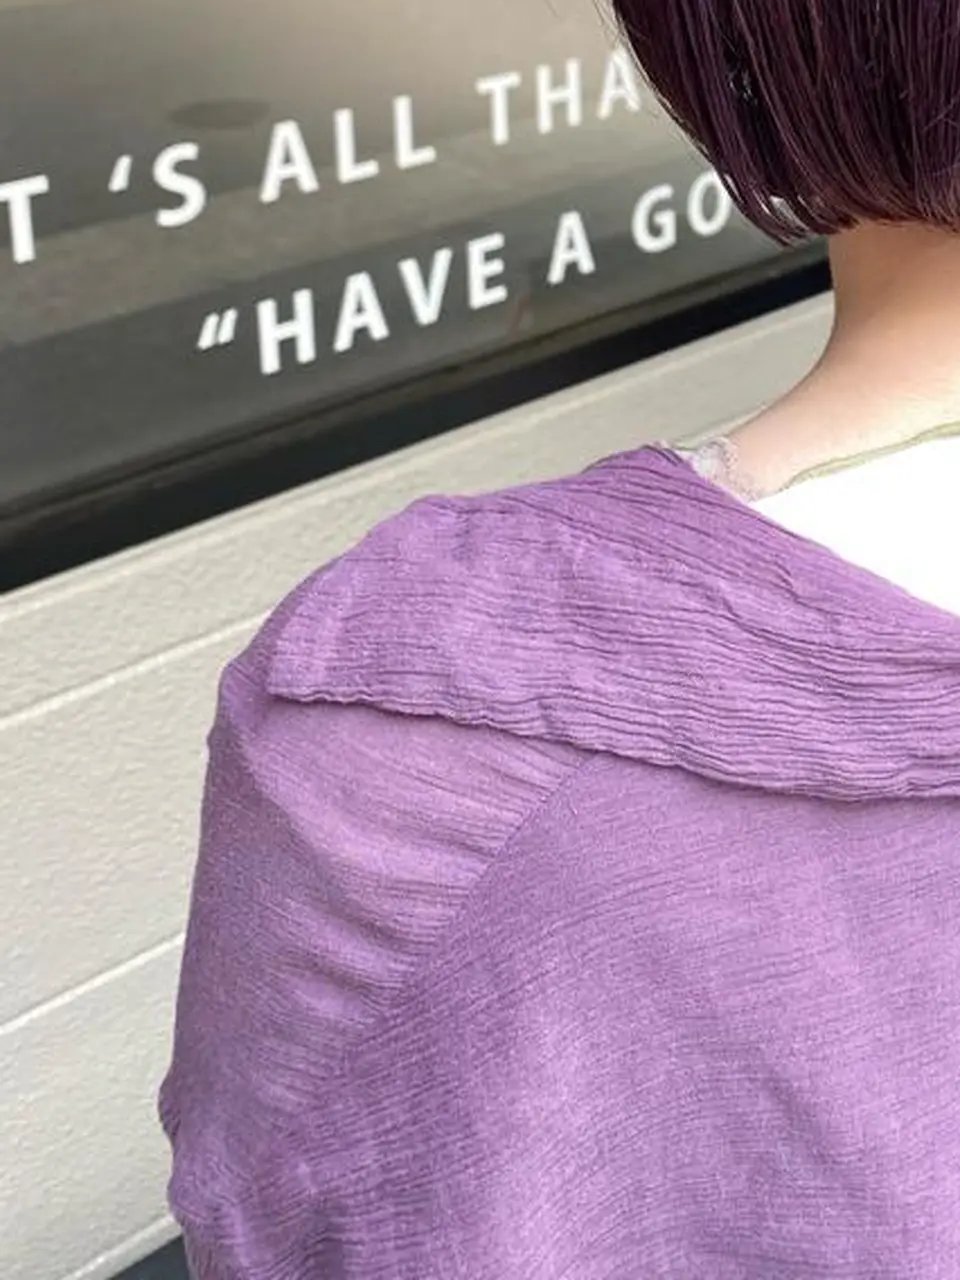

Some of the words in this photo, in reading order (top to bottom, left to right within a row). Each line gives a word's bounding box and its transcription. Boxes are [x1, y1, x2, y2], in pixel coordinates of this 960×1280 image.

[258, 95, 437, 205] ALL
[476, 45, 641, 147] THA
[546, 210, 596, 285] A
